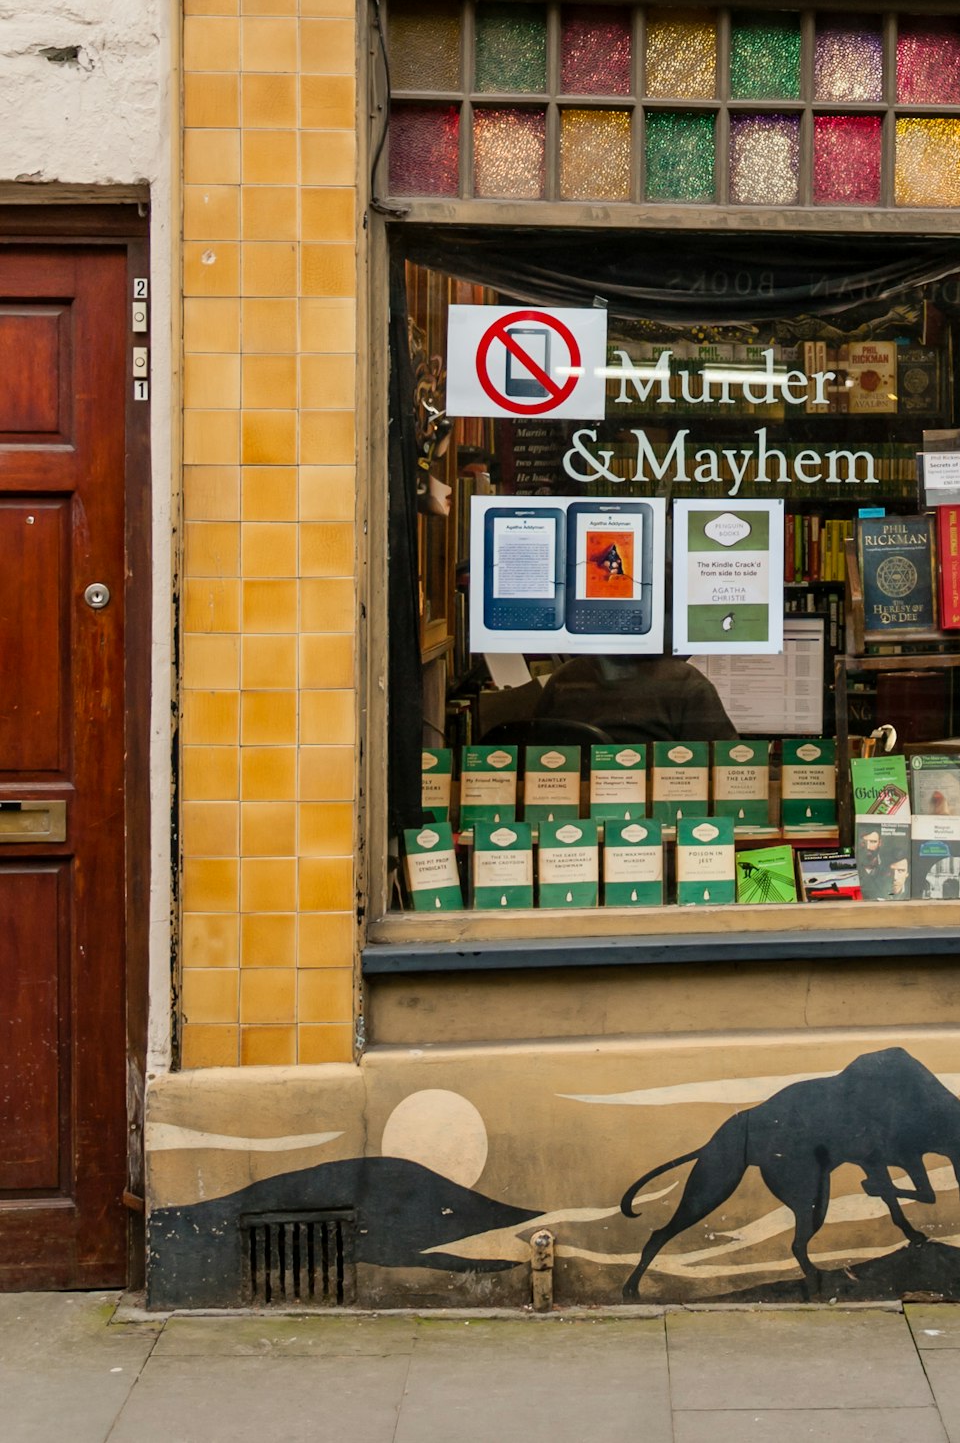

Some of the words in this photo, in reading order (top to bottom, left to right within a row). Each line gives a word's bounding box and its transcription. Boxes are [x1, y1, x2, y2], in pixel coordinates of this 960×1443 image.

[137, 280, 145, 296] 2
[862, 345, 877, 354] PHIL
[852, 354, 889, 364] RICKMAN
[614, 348, 836, 405] Murder
[138, 383, 144, 398] 1
[562, 428, 625, 483] &
[630, 427, 879, 496] Mayhem
[883, 524, 908, 534] PHIL
[865, 533, 928, 546] RICKMAN
[873, 605, 911, 614] HERESY
[418, 864, 447, 872] SYNDICATE
